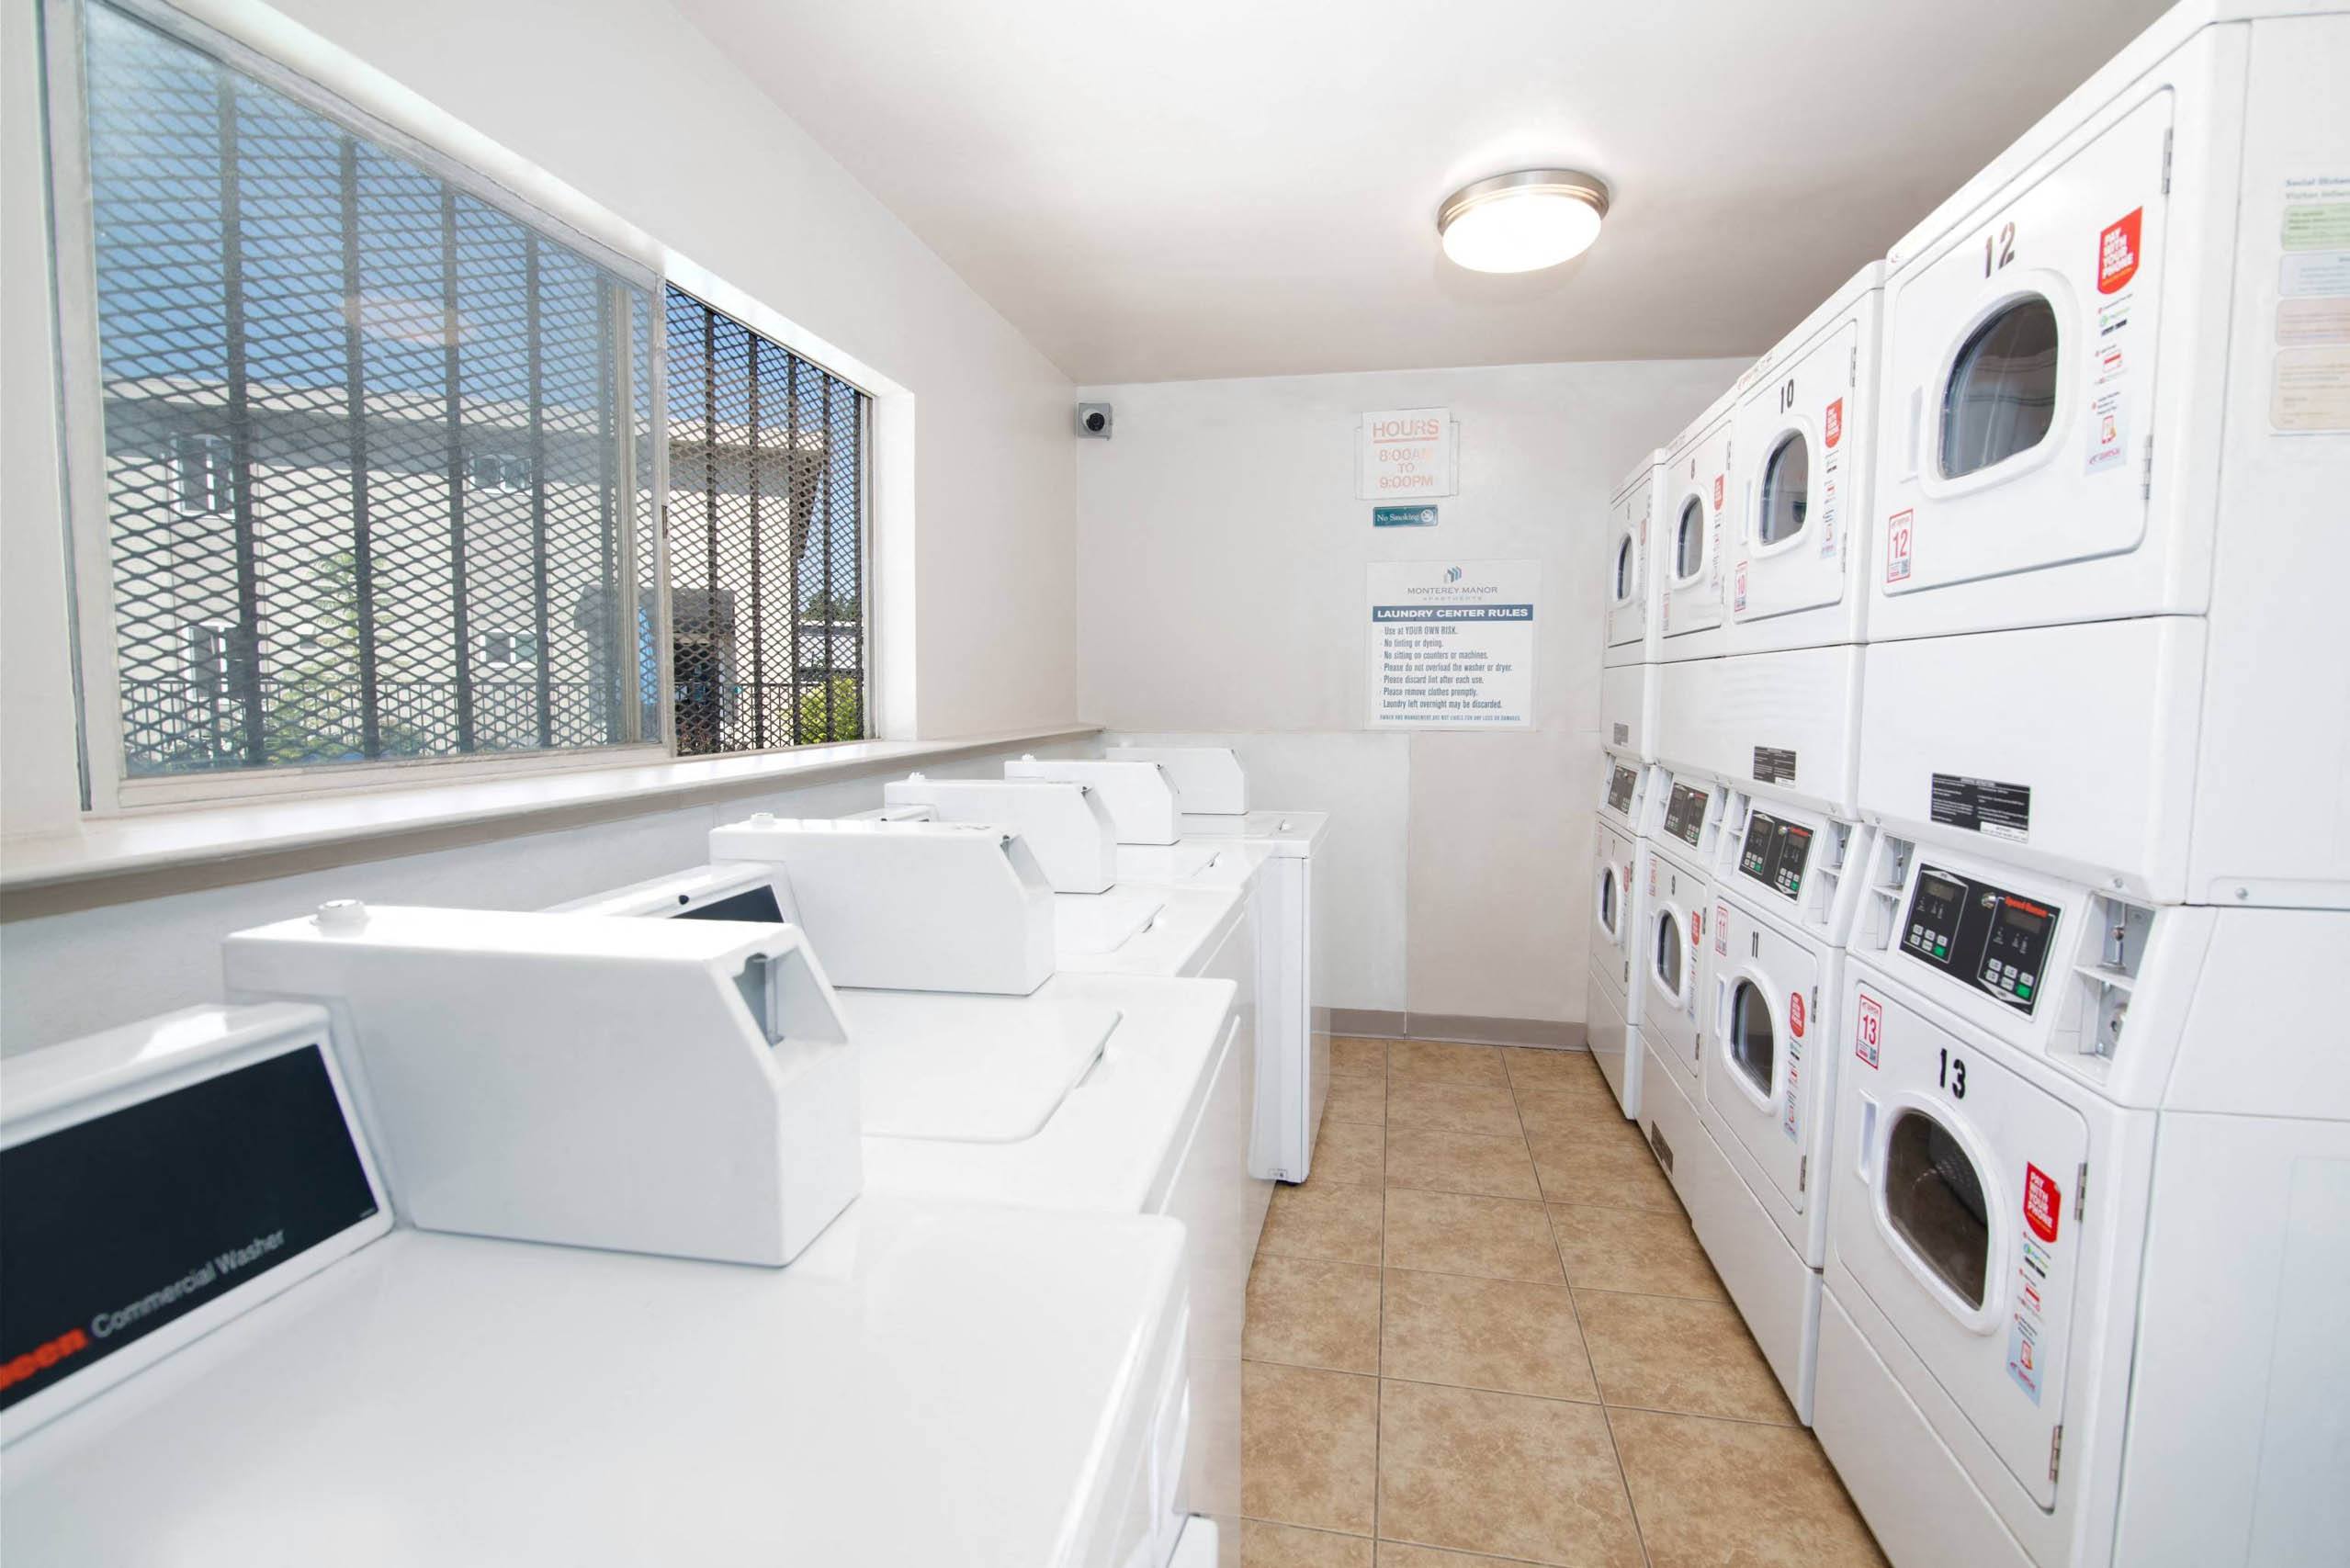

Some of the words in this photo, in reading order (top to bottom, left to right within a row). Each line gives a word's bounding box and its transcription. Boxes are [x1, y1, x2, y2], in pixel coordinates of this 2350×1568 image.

[1985, 221, 2016, 278] 12
[1780, 379, 1793, 413] 10
[1373, 419, 1440, 437] HOURS
[1379, 448, 1433, 462] 8:00A
[1397, 463, 1415, 473] TO
[1379, 475, 1433, 489] 9:00PM
[1390, 513, 1419, 522] Smoking
[1893, 529, 1907, 558] 12
[1377, 610, 1433, 618] LAUNDRY
[1384, 626, 1395, 635] Use
[1406, 626, 1422, 635] YOUR
[1424, 626, 1440, 635] OWN
[1422, 639, 1443, 649] dyeing.
[1394, 651, 1412, 660] sitting
[1384, 663, 1403, 671] Please
[1463, 663, 1485, 671] washer
[1496, 663, 1512, 672] dryer.
[1451, 688, 1477, 697] promptly.
[1383, 700, 1406, 709] Laundry
[1407, 700, 1418, 708] left
[1419, 700, 1447, 709] overnight
[1463, 700, 1470, 708] be
[1472, 700, 1502, 708] discarded.
[1752, 931, 1759, 958] 11
[1863, 1014, 1877, 1044] 13
[1940, 1048, 1966, 1100] 13
[92, 1262, 215, 1337] Commercial
[216, 1228, 286, 1274] Washer
